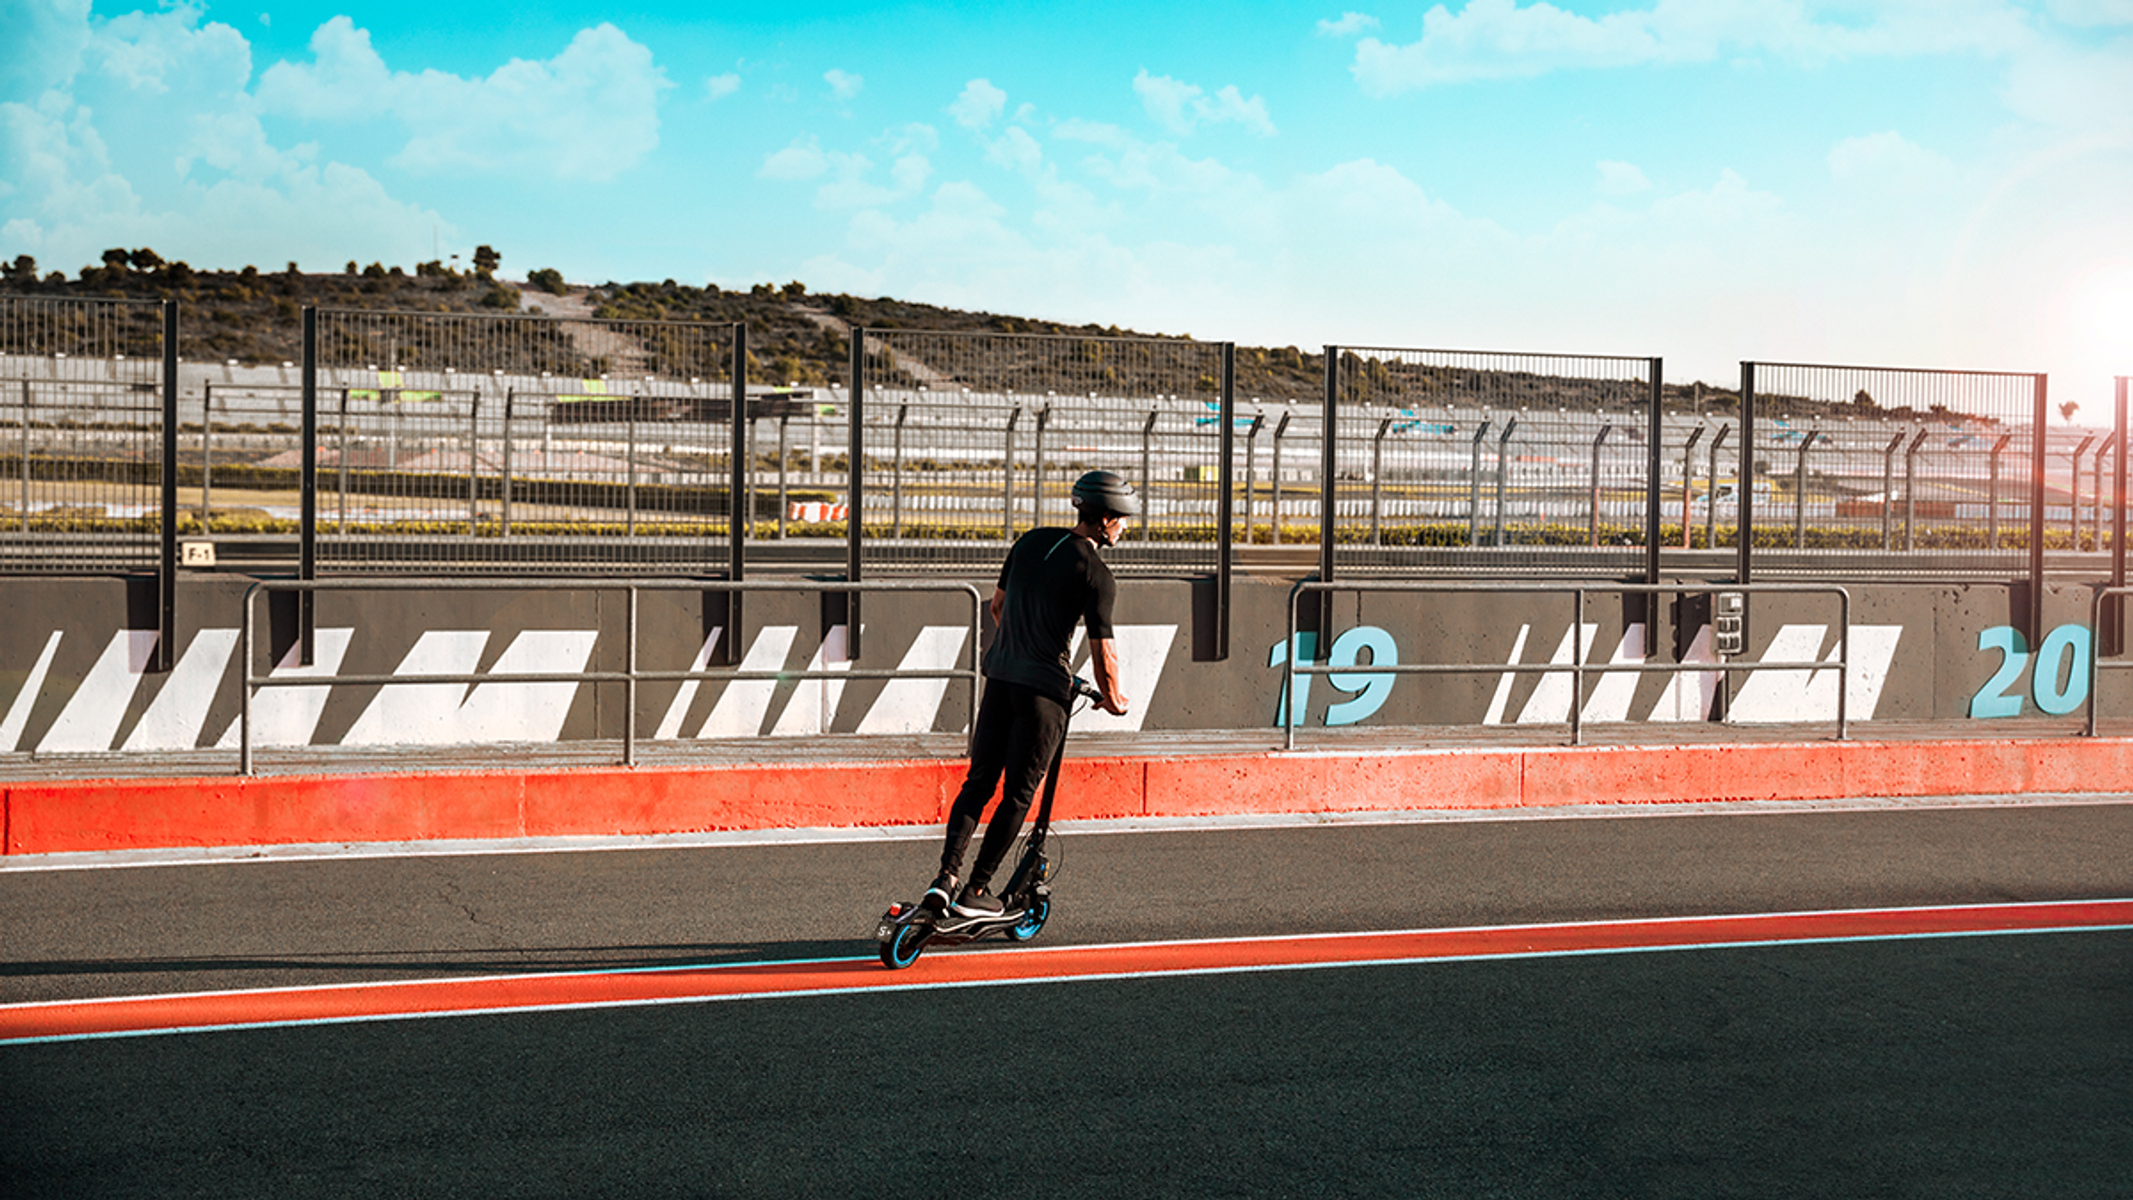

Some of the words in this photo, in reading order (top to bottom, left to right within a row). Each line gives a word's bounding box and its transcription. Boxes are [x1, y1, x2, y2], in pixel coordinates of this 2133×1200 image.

[188, 547, 210, 561] F-1
[1268, 625, 1398, 727] 19
[1970, 624, 2091, 718] 20
